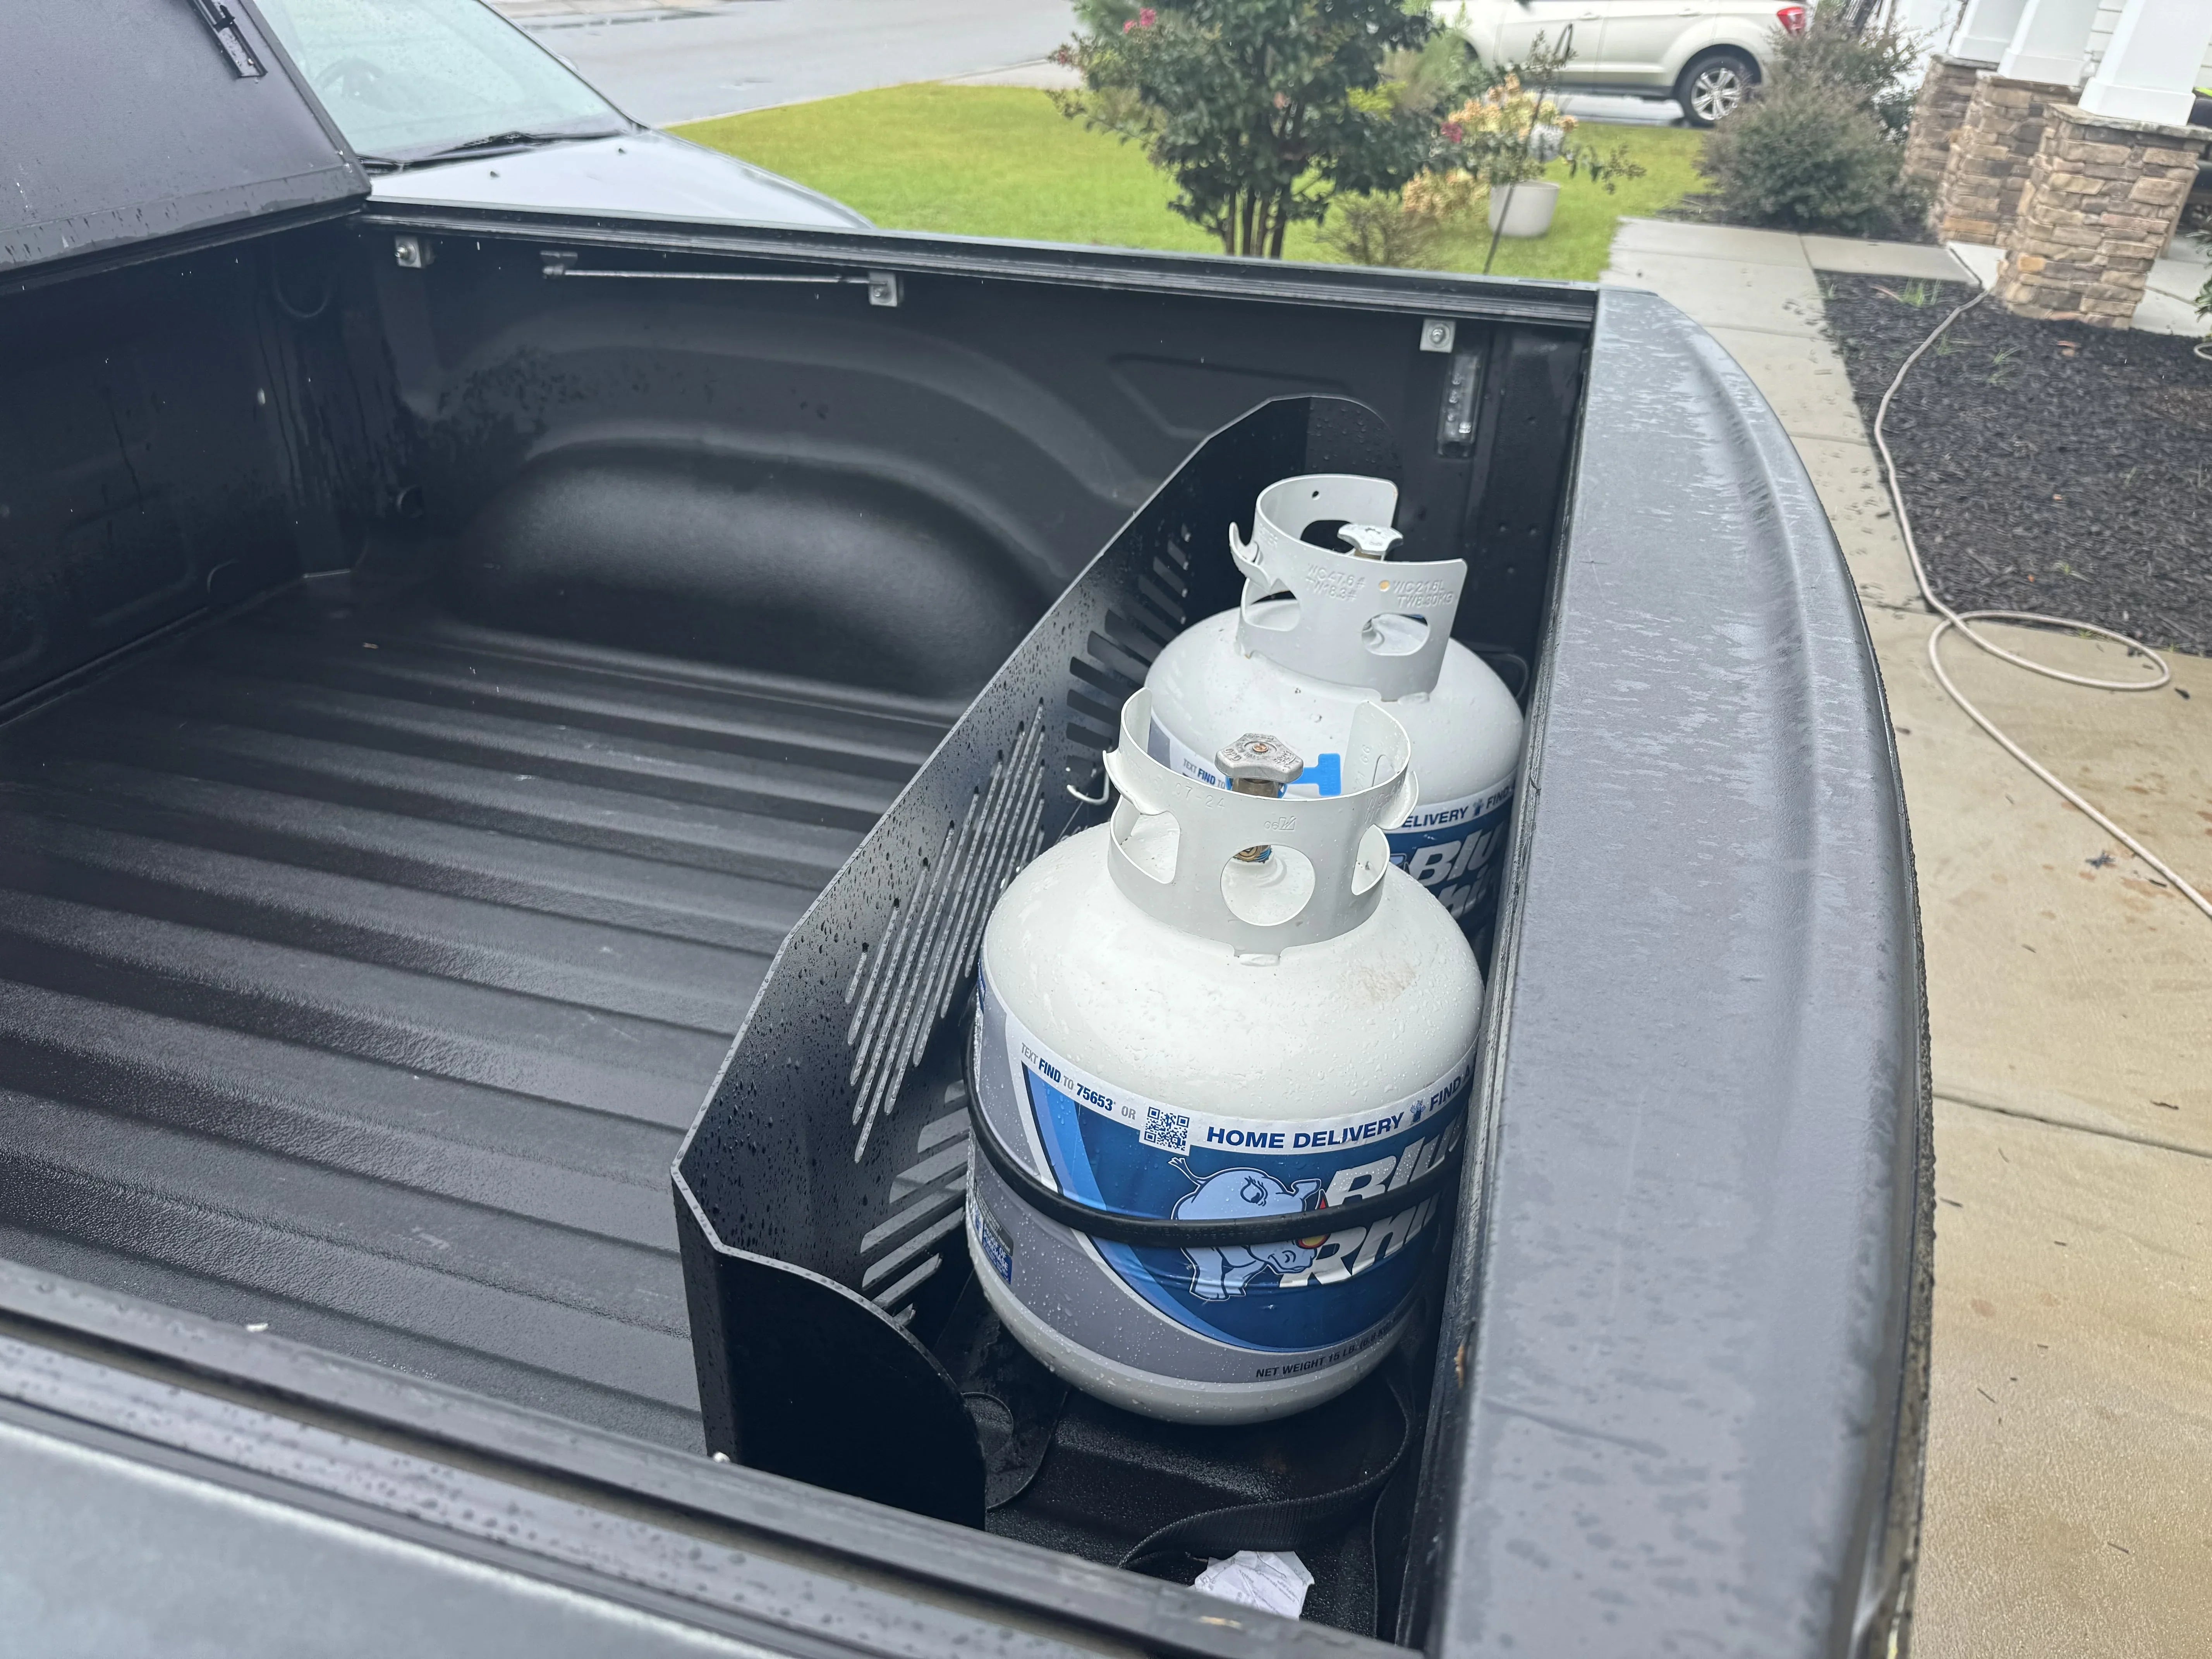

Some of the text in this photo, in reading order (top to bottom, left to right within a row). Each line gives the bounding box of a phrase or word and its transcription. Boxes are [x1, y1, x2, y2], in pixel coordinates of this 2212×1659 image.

[1183, 758, 1197, 774] TEXT
[1197, 768, 1216, 785] FIND
[1401, 805, 1469, 828] ELIVERY
[1021, 1042, 1039, 1065] TEXT
[1038, 1057, 1061, 1083] FIND
[1063, 1075, 1074, 1091] TO
[1121, 1106, 1137, 1120] OR
[1429, 1075, 1461, 1112] FIND
[1206, 1111, 1405, 1149] HOME DELIVERY
[999, 1248, 1007, 1259] OF
[1255, 1367, 1279, 1377] NET
[1283, 1356, 1326, 1375] WEIGHT
[1329, 1350, 1340, 1363] 15
